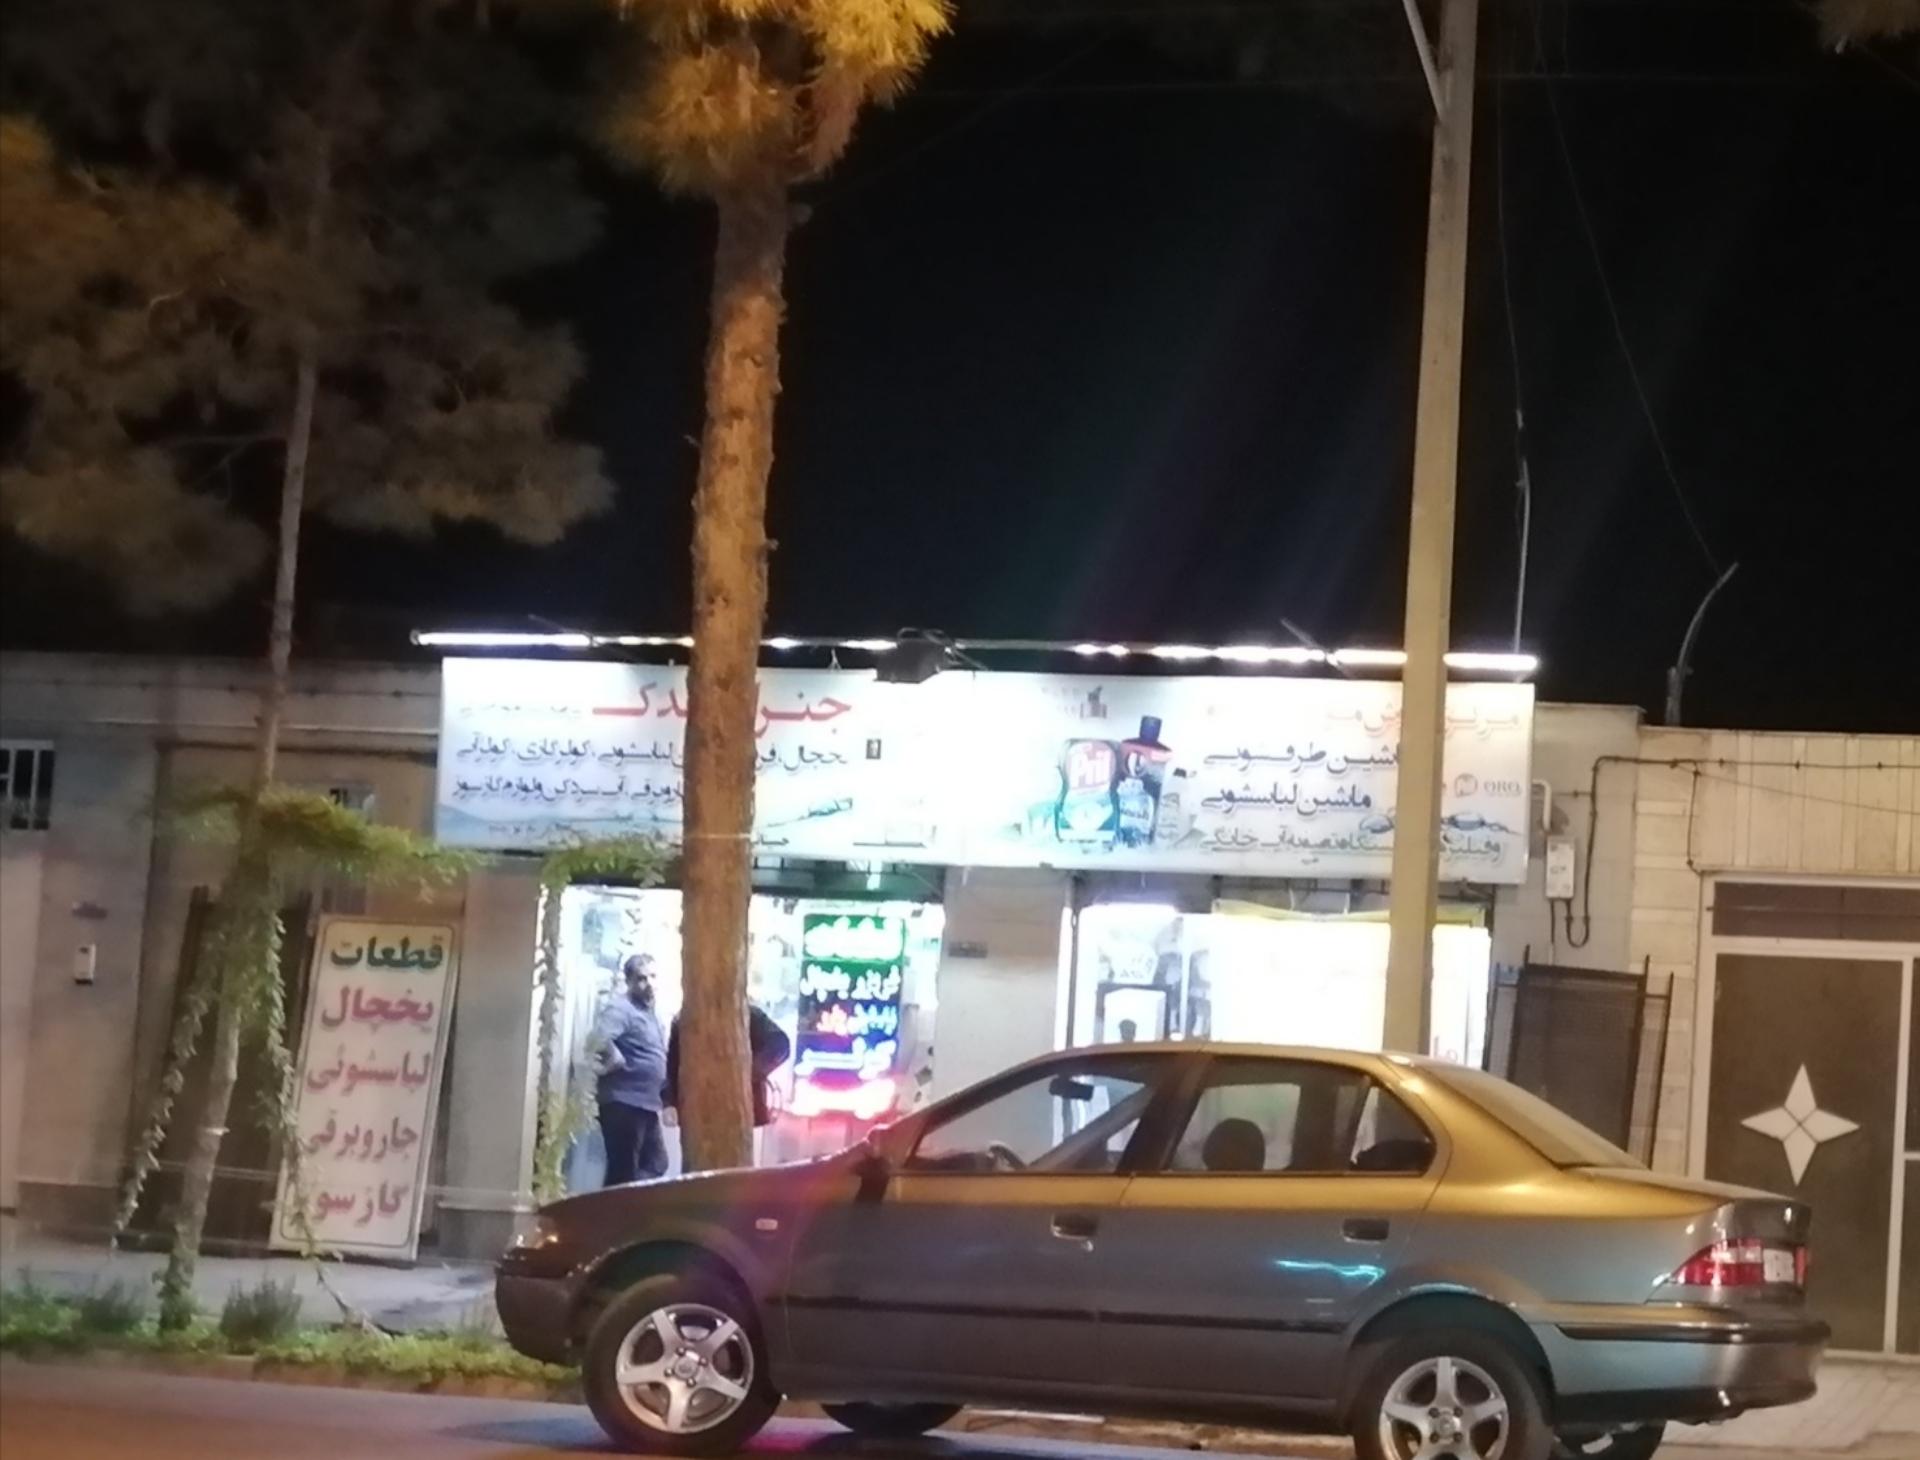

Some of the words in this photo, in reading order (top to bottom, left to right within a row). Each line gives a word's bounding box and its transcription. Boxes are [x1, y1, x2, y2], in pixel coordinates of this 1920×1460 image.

[592, 681, 688, 717] دک
[1297, 783, 1372, 815] ماشین
[330, 935, 444, 970] قطعات
[321, 985, 434, 1032] یخچال
